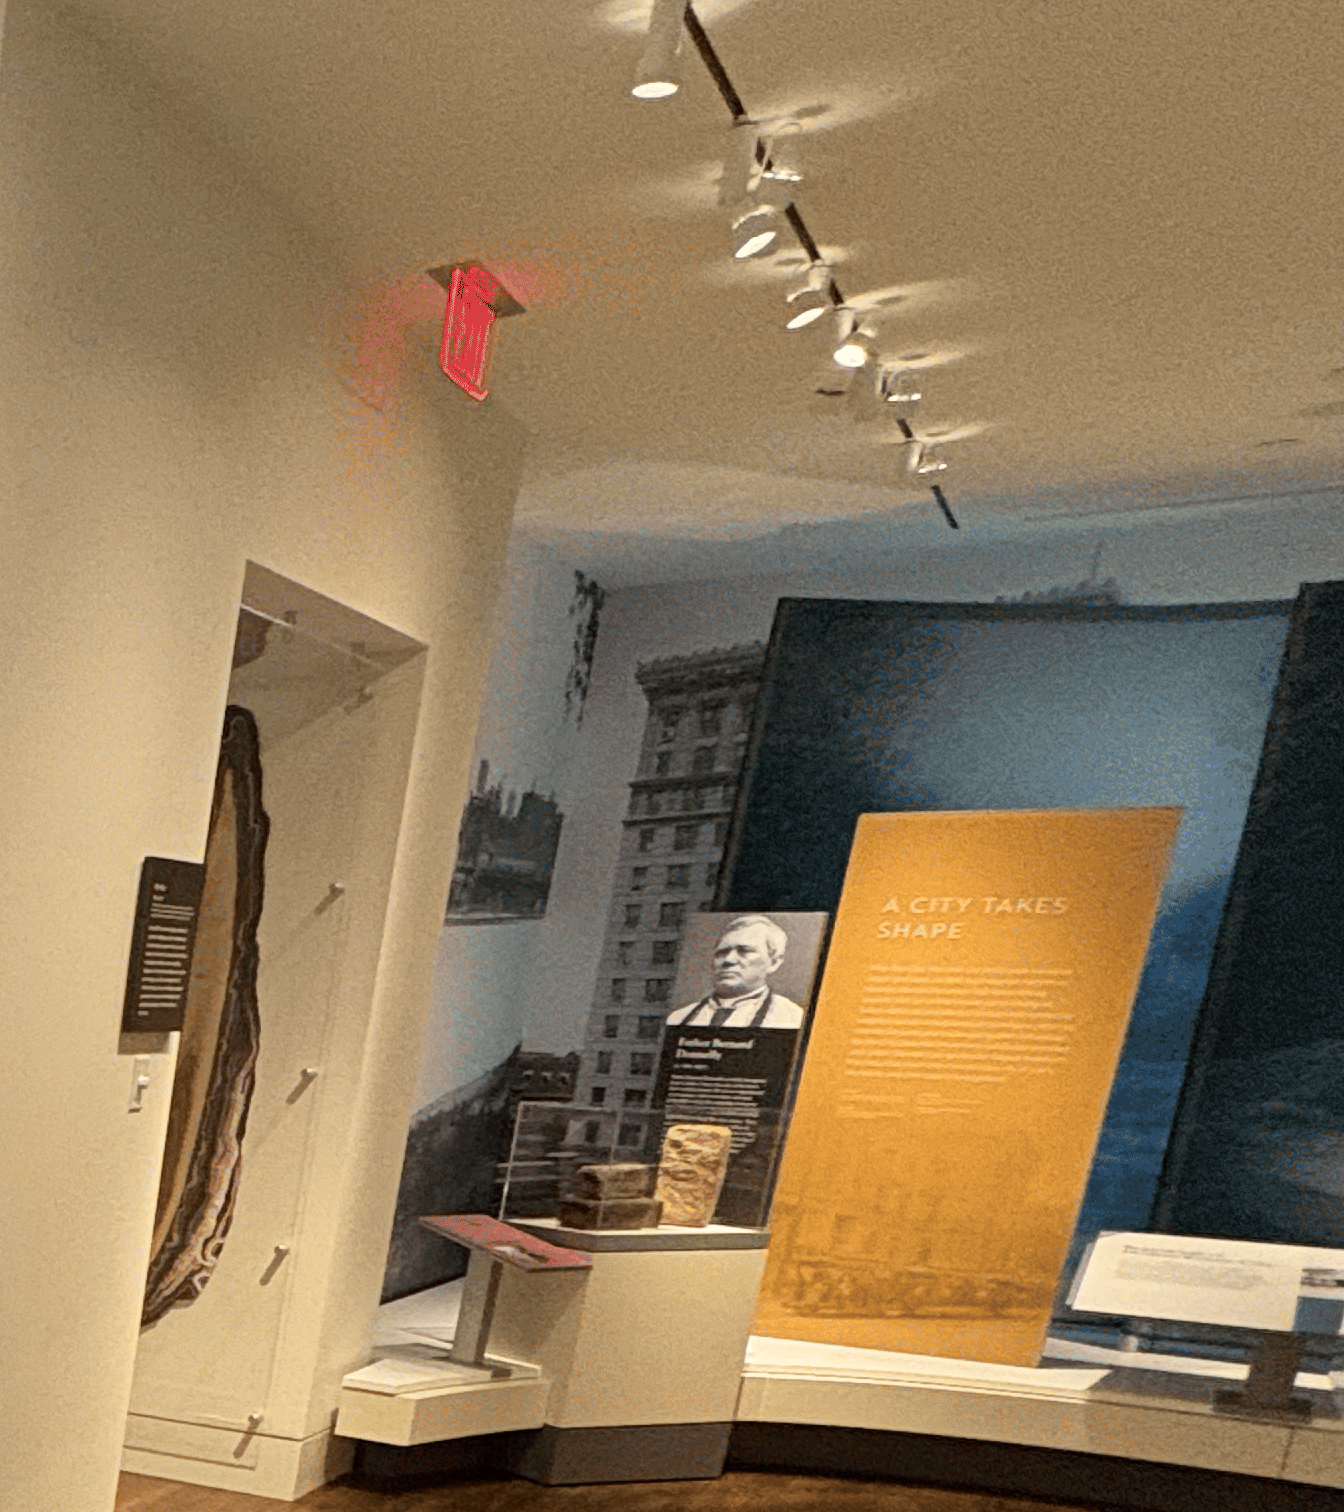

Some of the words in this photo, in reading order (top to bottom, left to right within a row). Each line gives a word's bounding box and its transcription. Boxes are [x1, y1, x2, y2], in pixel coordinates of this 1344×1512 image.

[880, 896, 899, 913] A
[909, 896, 973, 914] CITY
[982, 897, 1069, 914] TAKES
[877, 921, 965, 939] SHAPE
